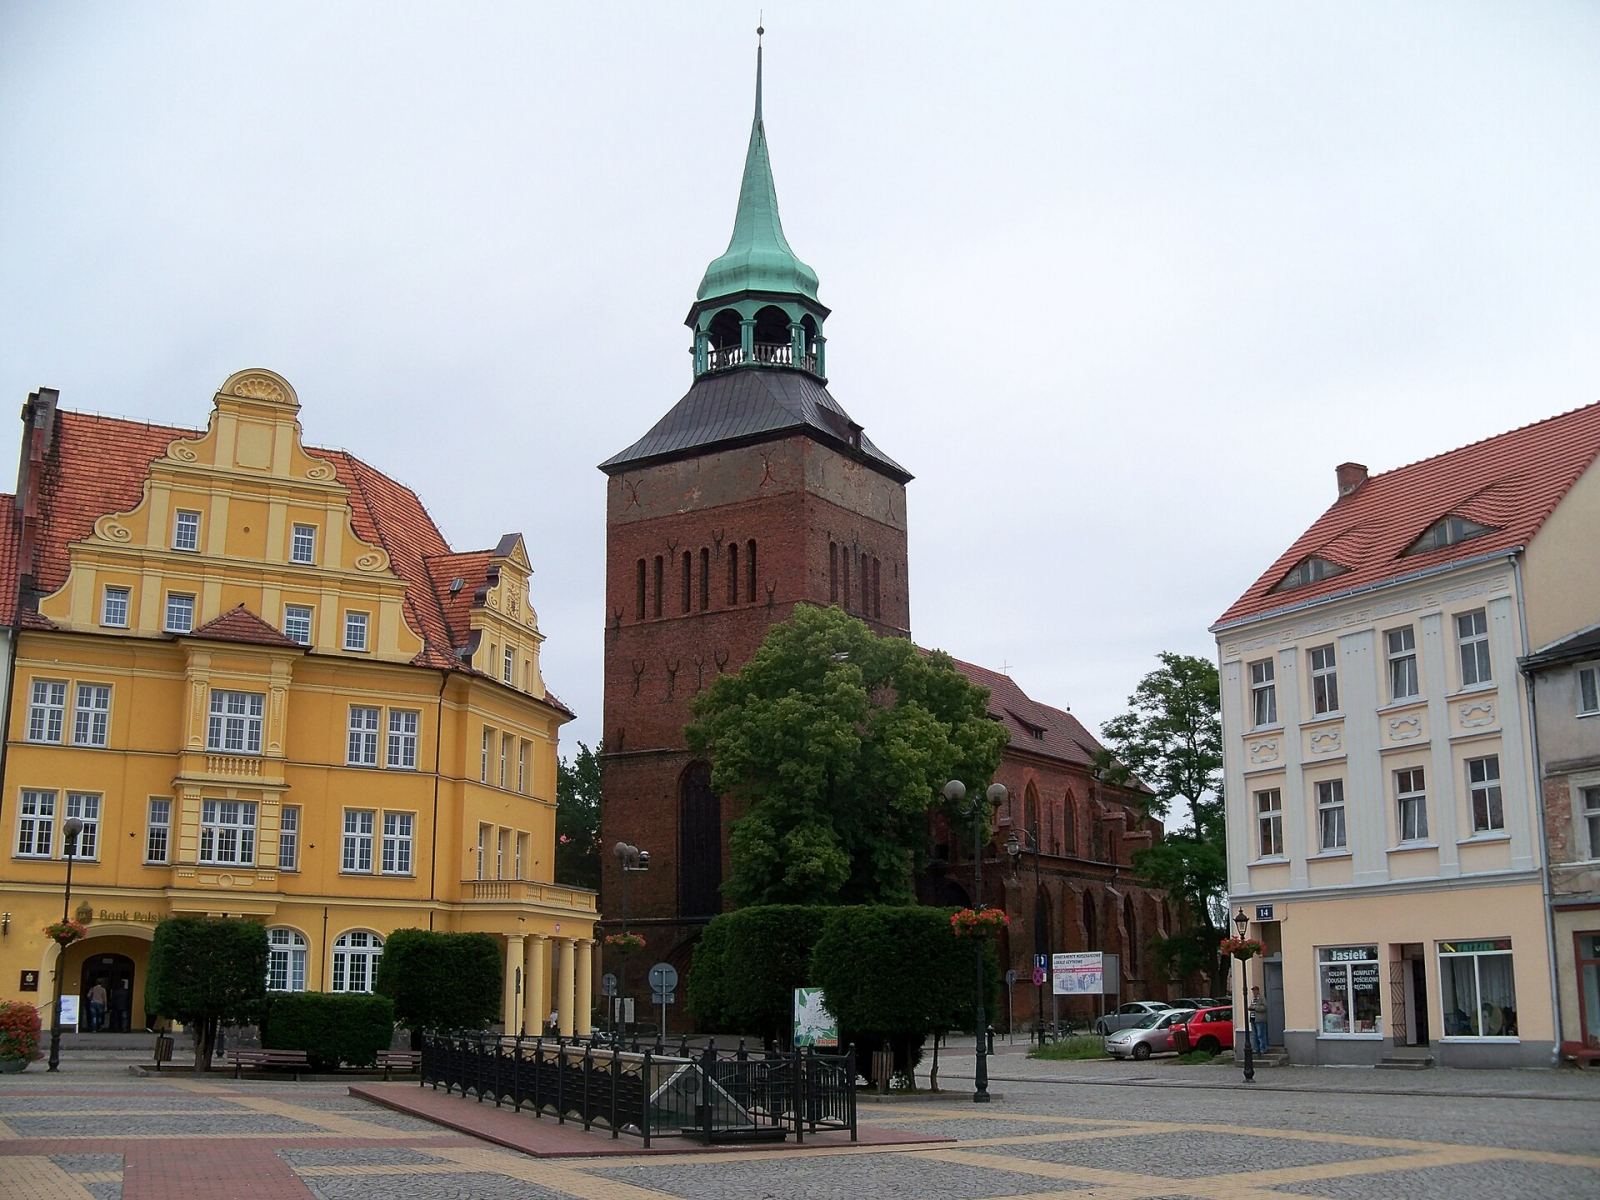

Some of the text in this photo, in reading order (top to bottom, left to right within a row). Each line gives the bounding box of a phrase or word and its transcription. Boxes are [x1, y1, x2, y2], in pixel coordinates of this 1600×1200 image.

[100, 909, 129, 921] Bank
[1260, 909, 1269, 917] 14
[1332, 949, 1367, 960] Jasiek
